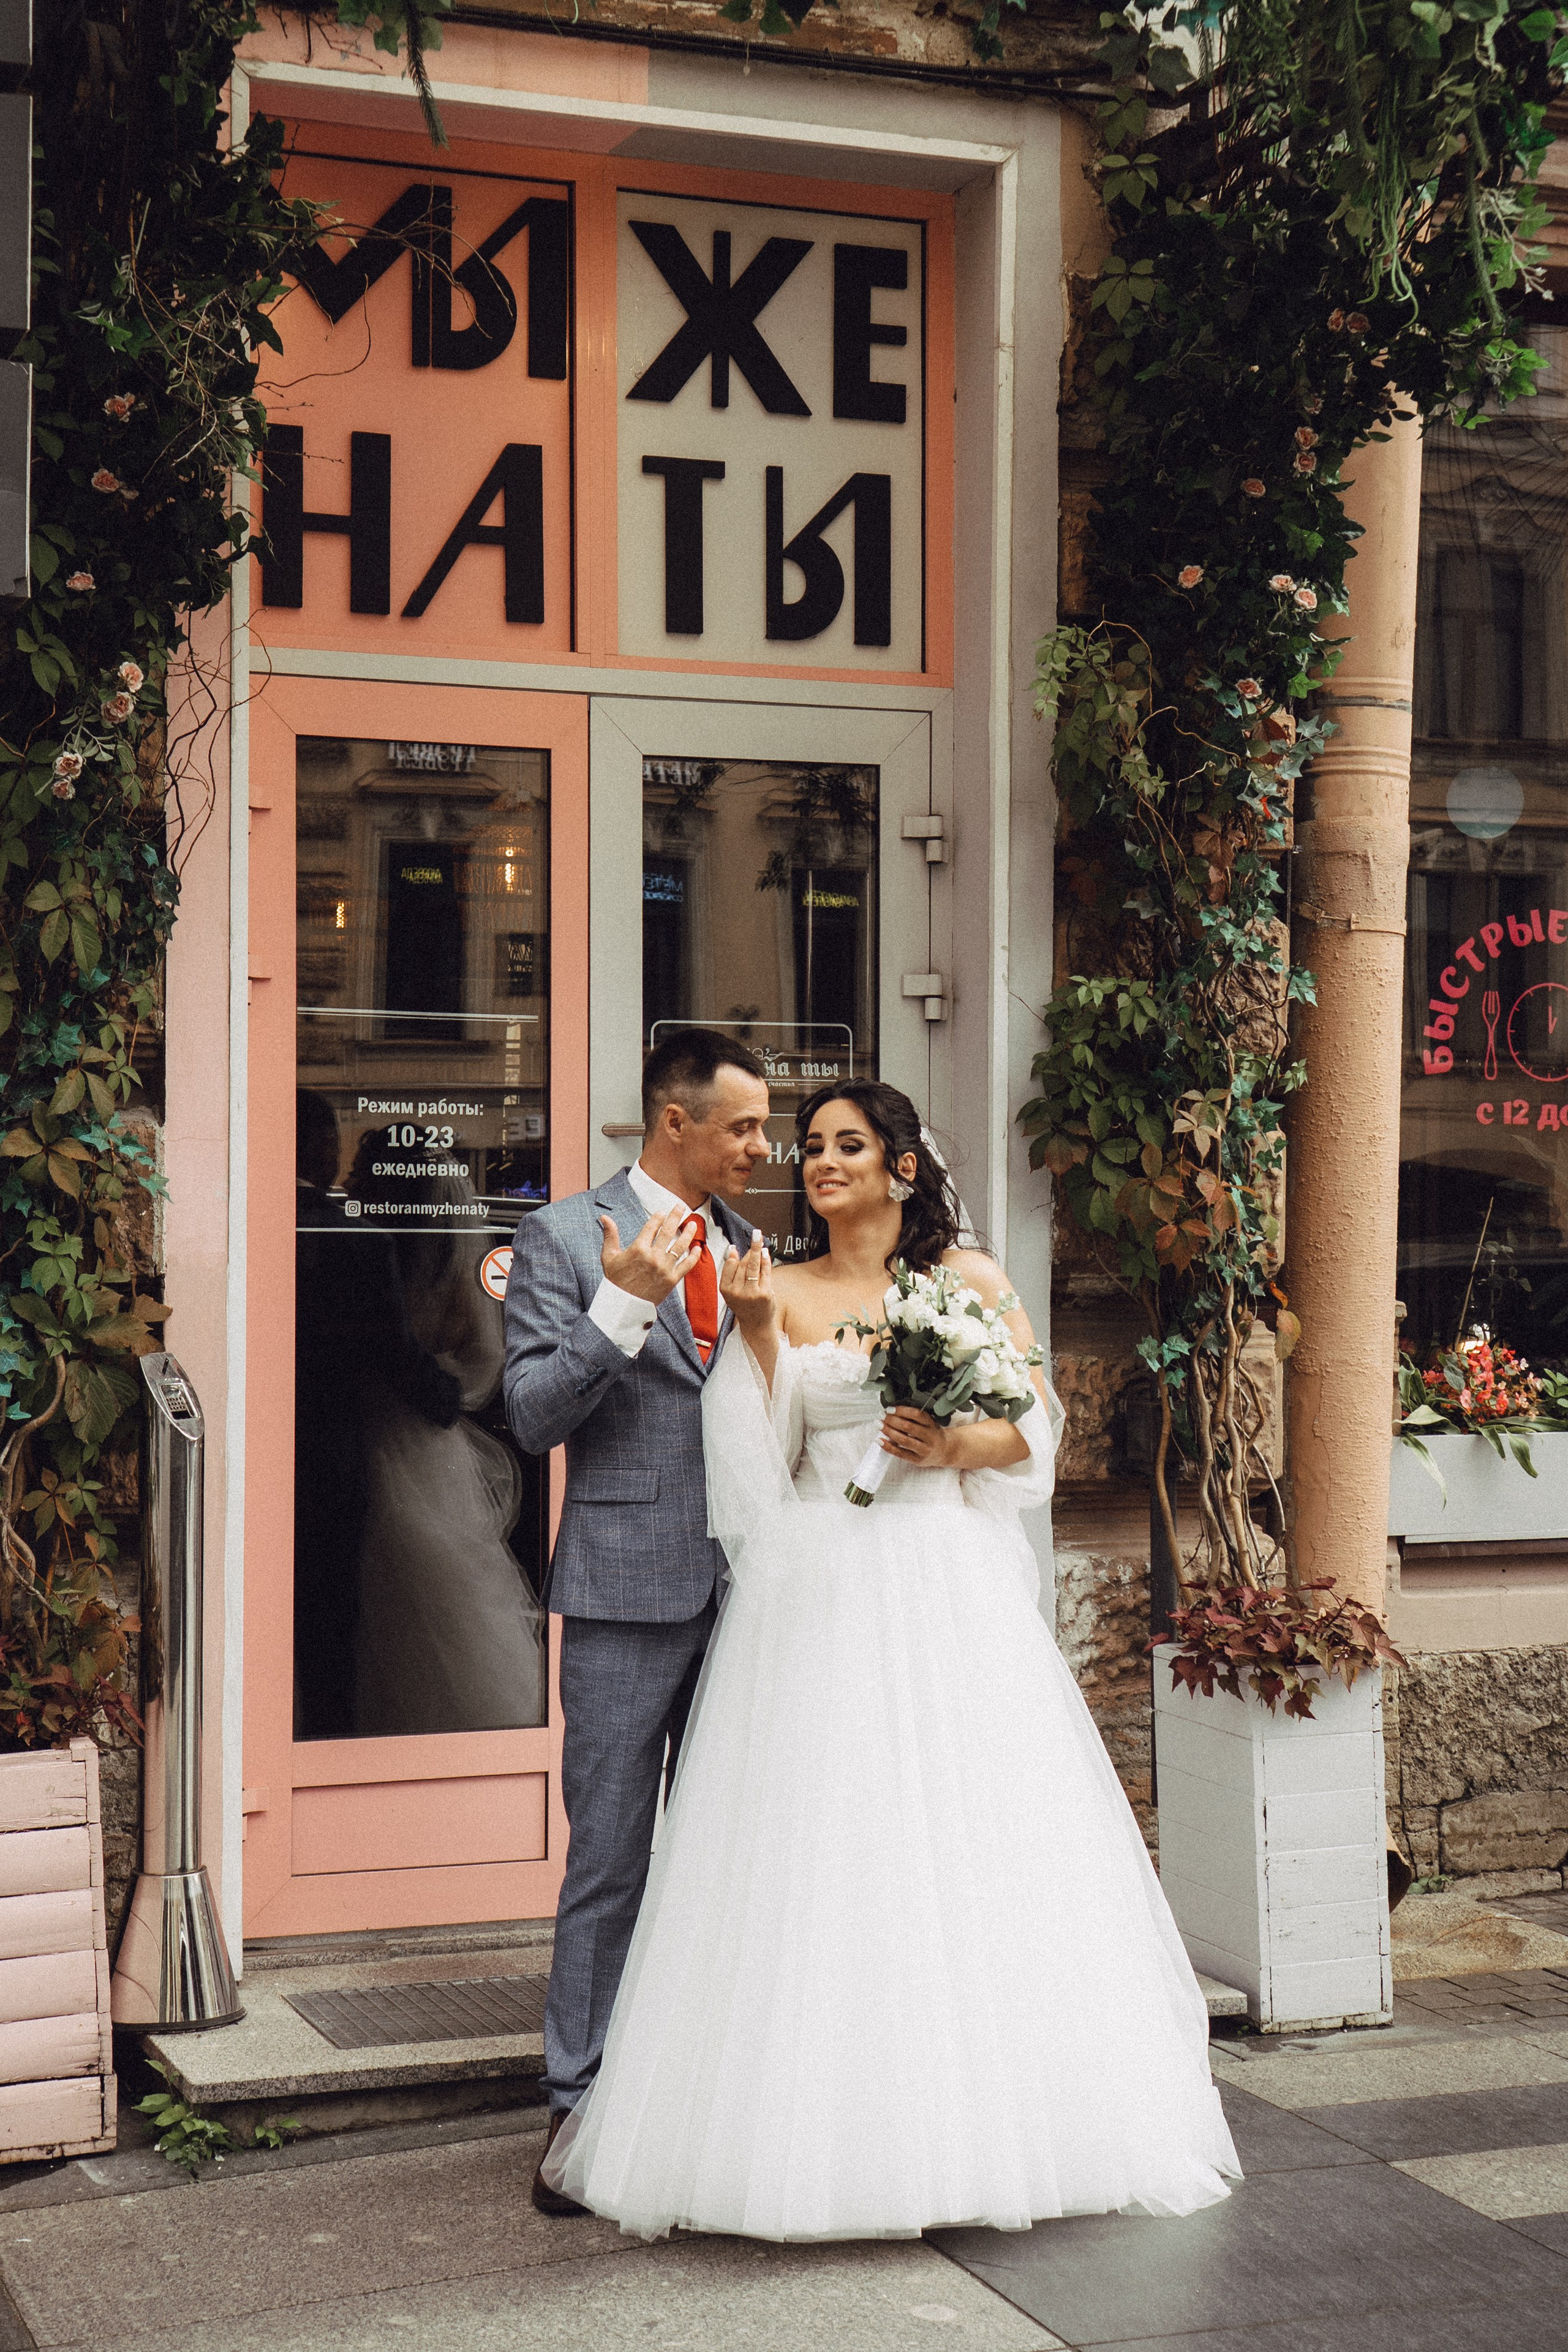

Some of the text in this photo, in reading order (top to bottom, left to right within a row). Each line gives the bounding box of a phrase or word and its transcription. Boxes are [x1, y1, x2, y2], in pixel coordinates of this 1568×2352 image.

[626, 219, 909, 424] ЖЕ
[262, 423, 892, 647] НА ТЫ
[1423, 909, 1568, 1076] БЫСТРЫЕ
[358, 1097, 484, 1117] Режим работы:
[1503, 1099, 1529, 1125] 12
[387, 1125, 454, 1148] 10-23
[372, 1163, 469, 1178] ежедневно
[364, 1202, 490, 1218] restoranmyzhenaty
